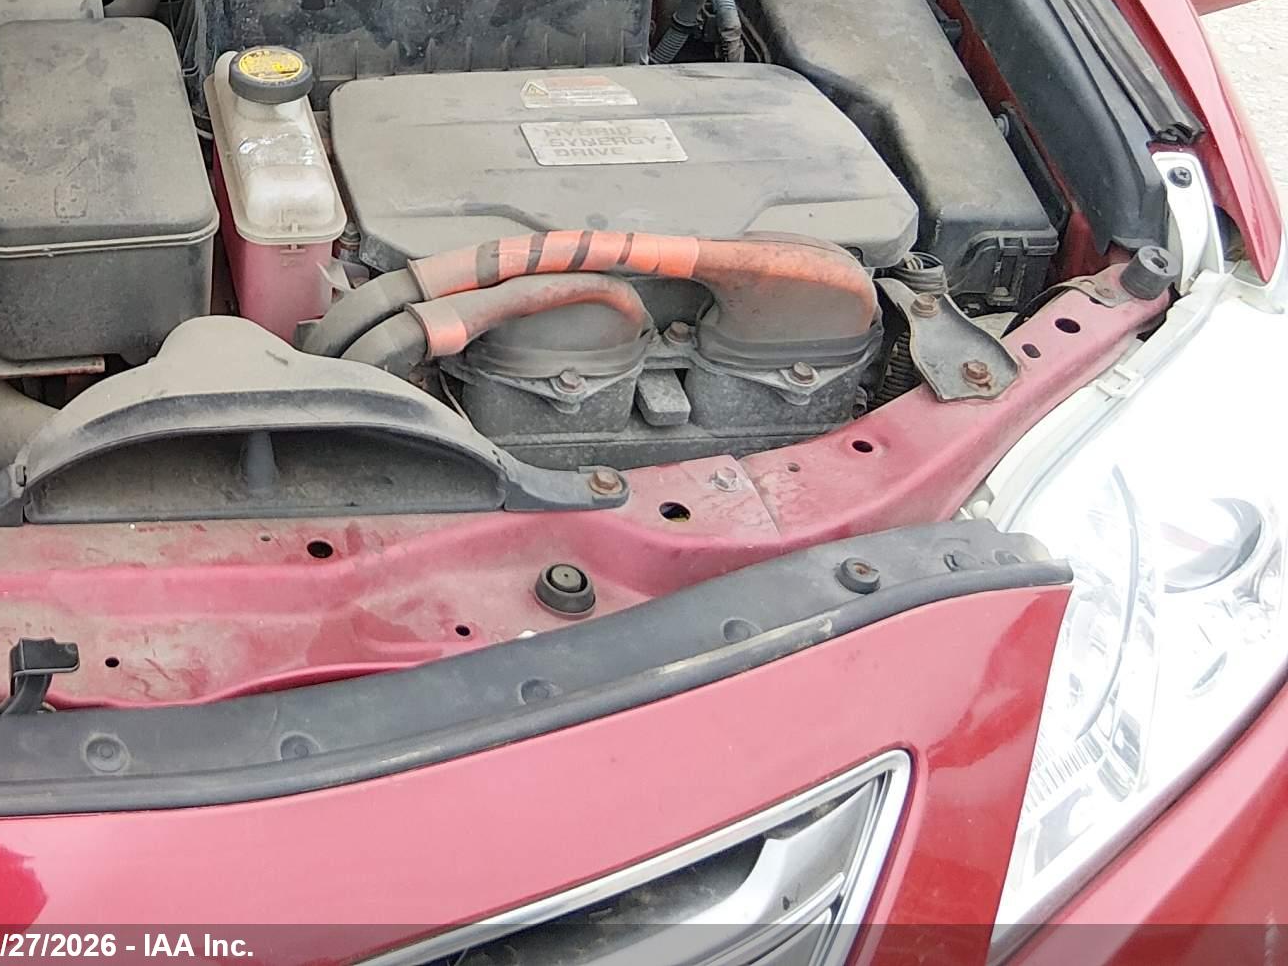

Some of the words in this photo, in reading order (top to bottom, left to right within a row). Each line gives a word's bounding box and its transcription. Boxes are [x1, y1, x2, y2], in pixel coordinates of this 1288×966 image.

[544, 127, 631, 137] HYBRID
[550, 136, 658, 147] SYNERGY
[555, 147, 624, 157] DRIVE
